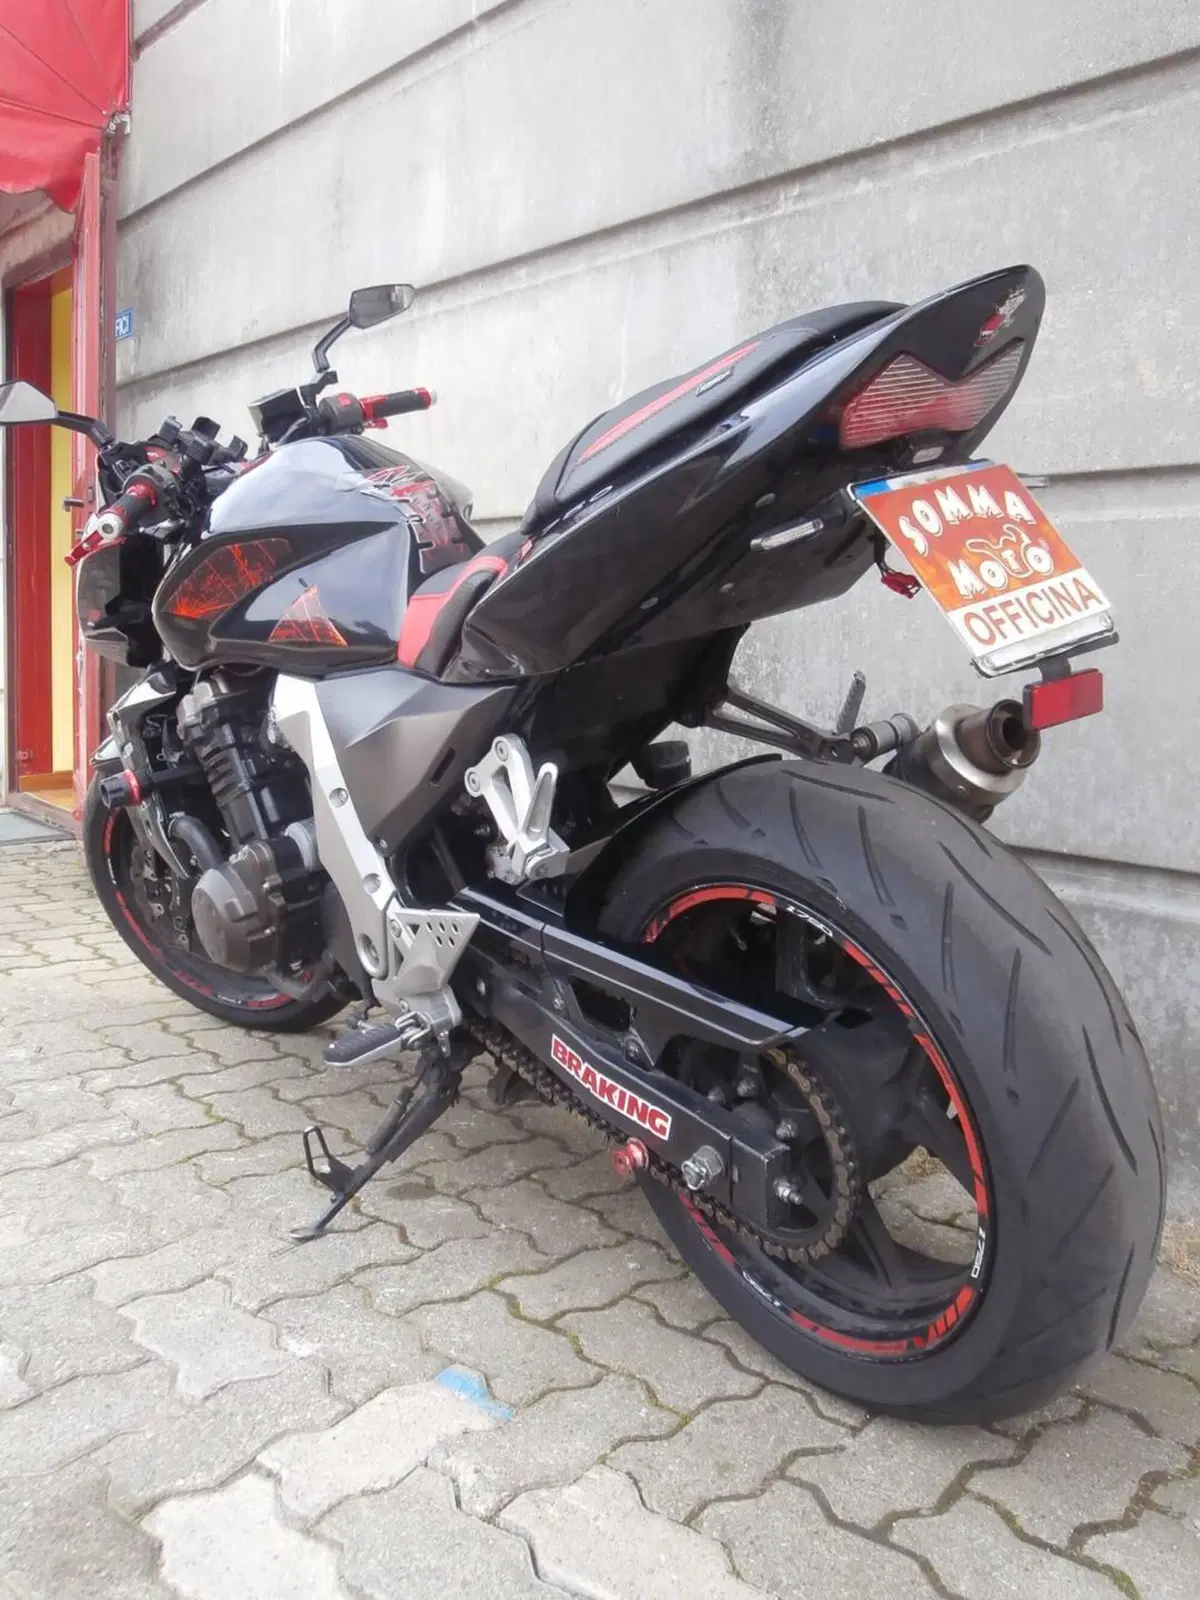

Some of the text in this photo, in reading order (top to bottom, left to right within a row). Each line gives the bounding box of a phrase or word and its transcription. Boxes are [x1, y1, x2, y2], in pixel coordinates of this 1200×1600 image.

[898, 484, 1036, 557] SOMMA
[947, 544, 1054, 599] MOTO
[963, 577, 1103, 645] OFFICINA
[552, 1035, 671, 1140] BRAKING
